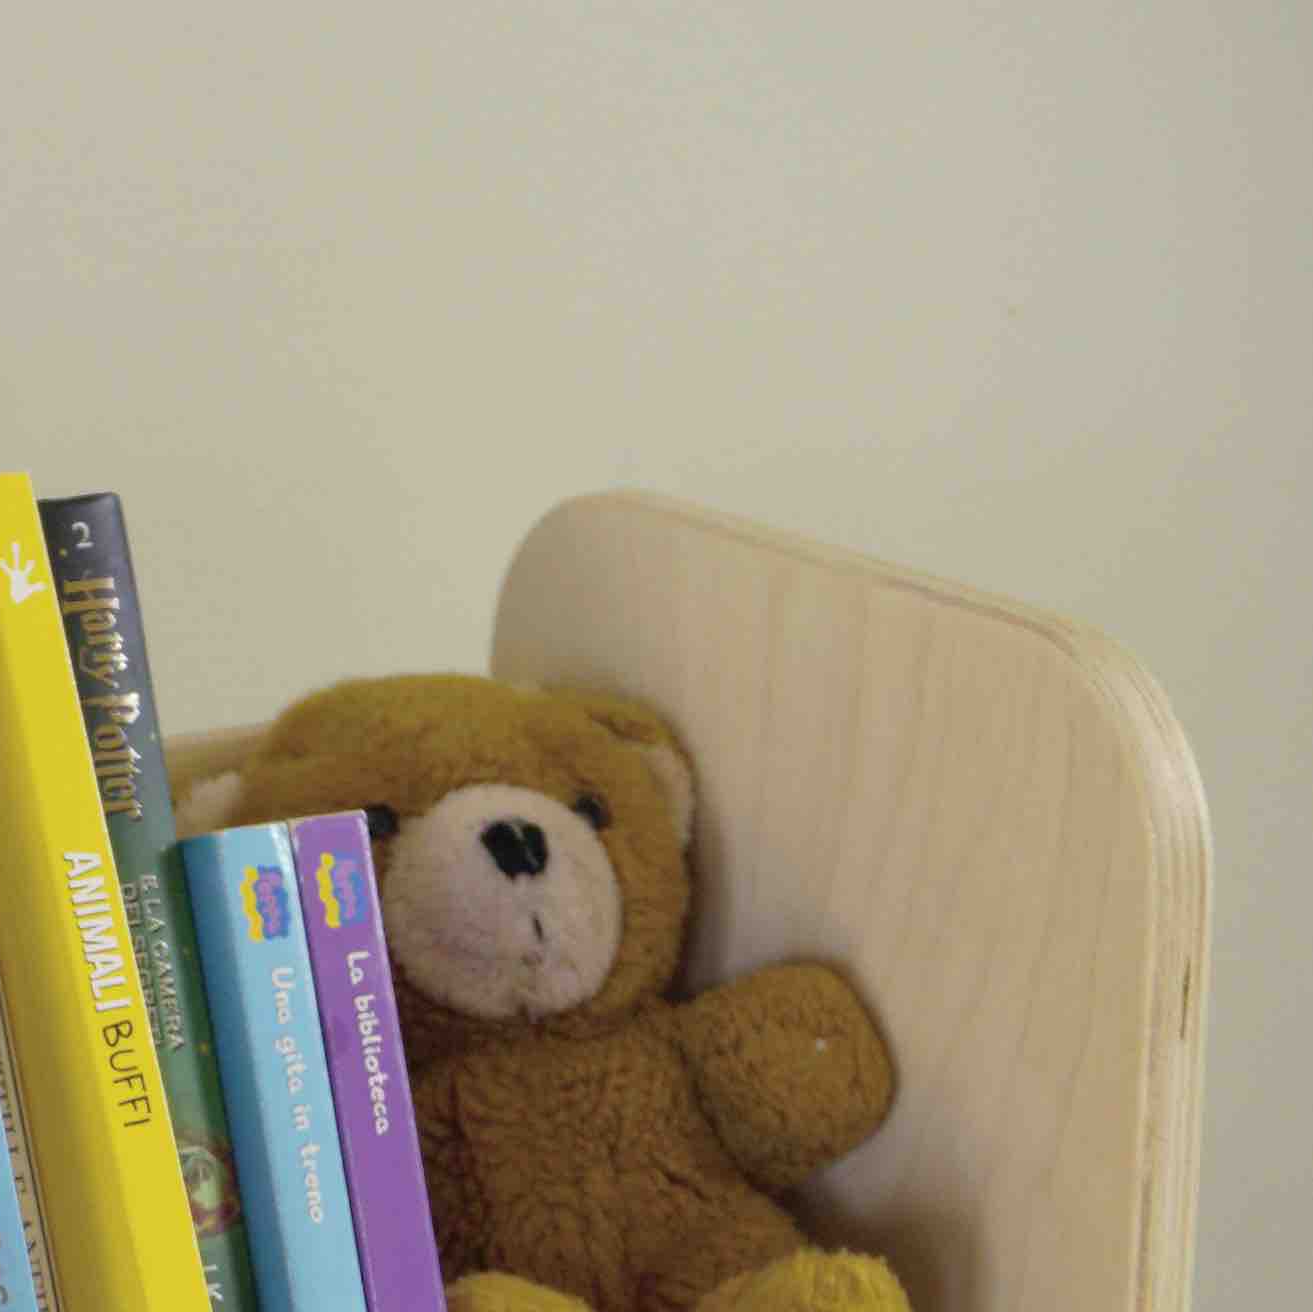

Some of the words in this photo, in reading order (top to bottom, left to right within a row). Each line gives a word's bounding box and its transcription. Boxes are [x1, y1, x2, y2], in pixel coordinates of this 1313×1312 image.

[71, 521, 94, 548] 2
[62, 577, 128, 689] Harry
[63, 850, 134, 1013] ANIMALI
[102, 1018, 153, 1128] BUFFI
[272, 967, 297, 1025] Una
[344, 950, 370, 985] La
[273, 1034, 312, 1094] gita
[353, 993, 390, 1135] biblioteca
[292, 1103, 312, 1131] in
[299, 1143, 325, 1224] treno
